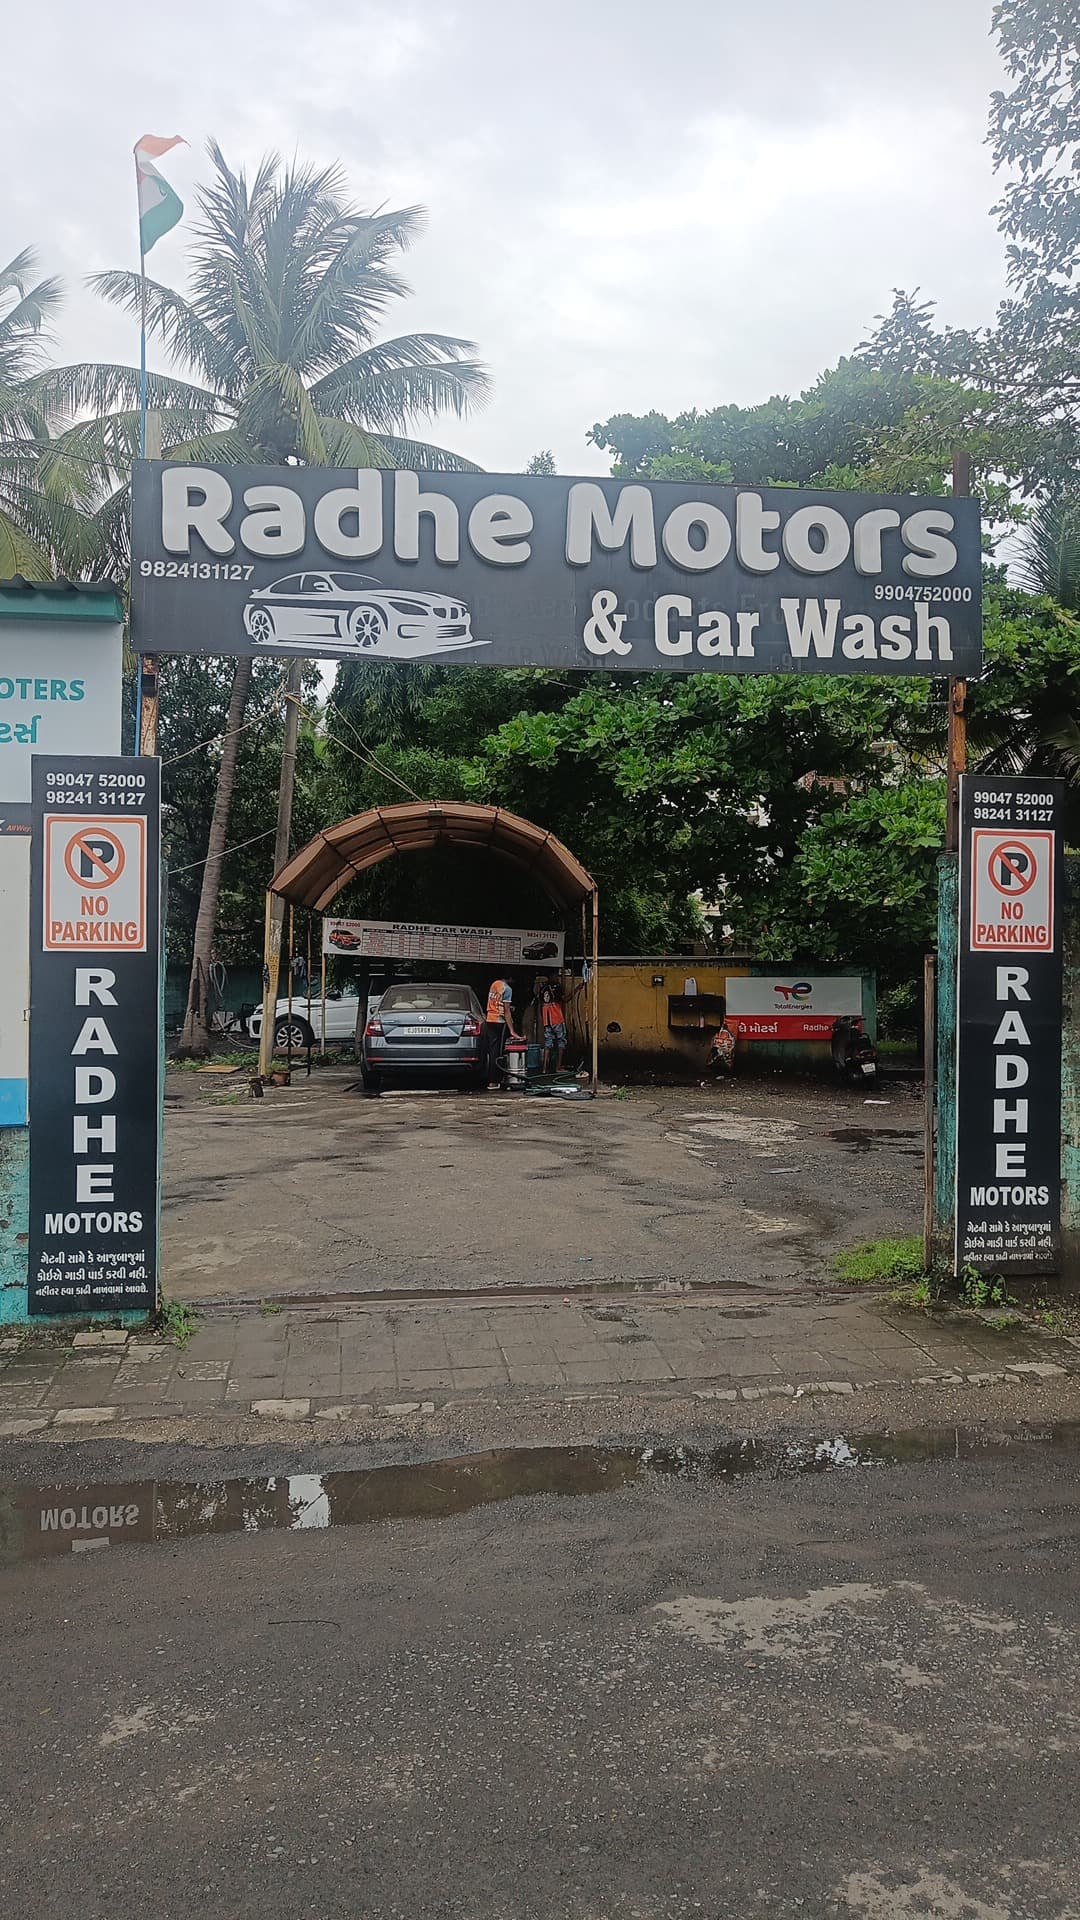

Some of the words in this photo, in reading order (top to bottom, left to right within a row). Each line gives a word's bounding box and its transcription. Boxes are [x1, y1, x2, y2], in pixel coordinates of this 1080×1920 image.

[161, 466, 534, 566] Radhe
[566, 482, 958, 577] Motors
[140, 561, 255, 581] 9824131127
[874, 585, 972, 602] 9904752000
[583, 590, 632, 656] &
[654, 594, 760, 657] Car
[781, 598, 954, 661] Wash
[46, 773, 94, 787] 99047
[98, 774, 146, 788] 52000
[46, 791, 93, 805] 98241
[98, 792, 146, 806] 31127
[974, 792, 1012, 805] 99047
[1016, 793, 1054, 806] 52000
[974, 808, 1011, 821] 98241
[1016, 809, 1053, 822] 31127
[81, 895, 109, 916] NO
[1001, 902, 1024, 920] NO
[51, 921, 138, 942] PARKING
[393, 924, 430, 932] RADHE
[459, 928, 493, 936] WASH
[977, 924, 1047, 943] PARKING
[803, 1023, 829, 1032] Radhe
[993, 966, 1031, 1178] RADHE
[71, 968, 119, 1203] RADHE
[970, 1185, 1049, 1206] MOTORS
[44, 1211, 143, 1235] MOTORS
[1004, 1220, 1010, 1232] કે
[88, 1250, 94, 1263] કે
